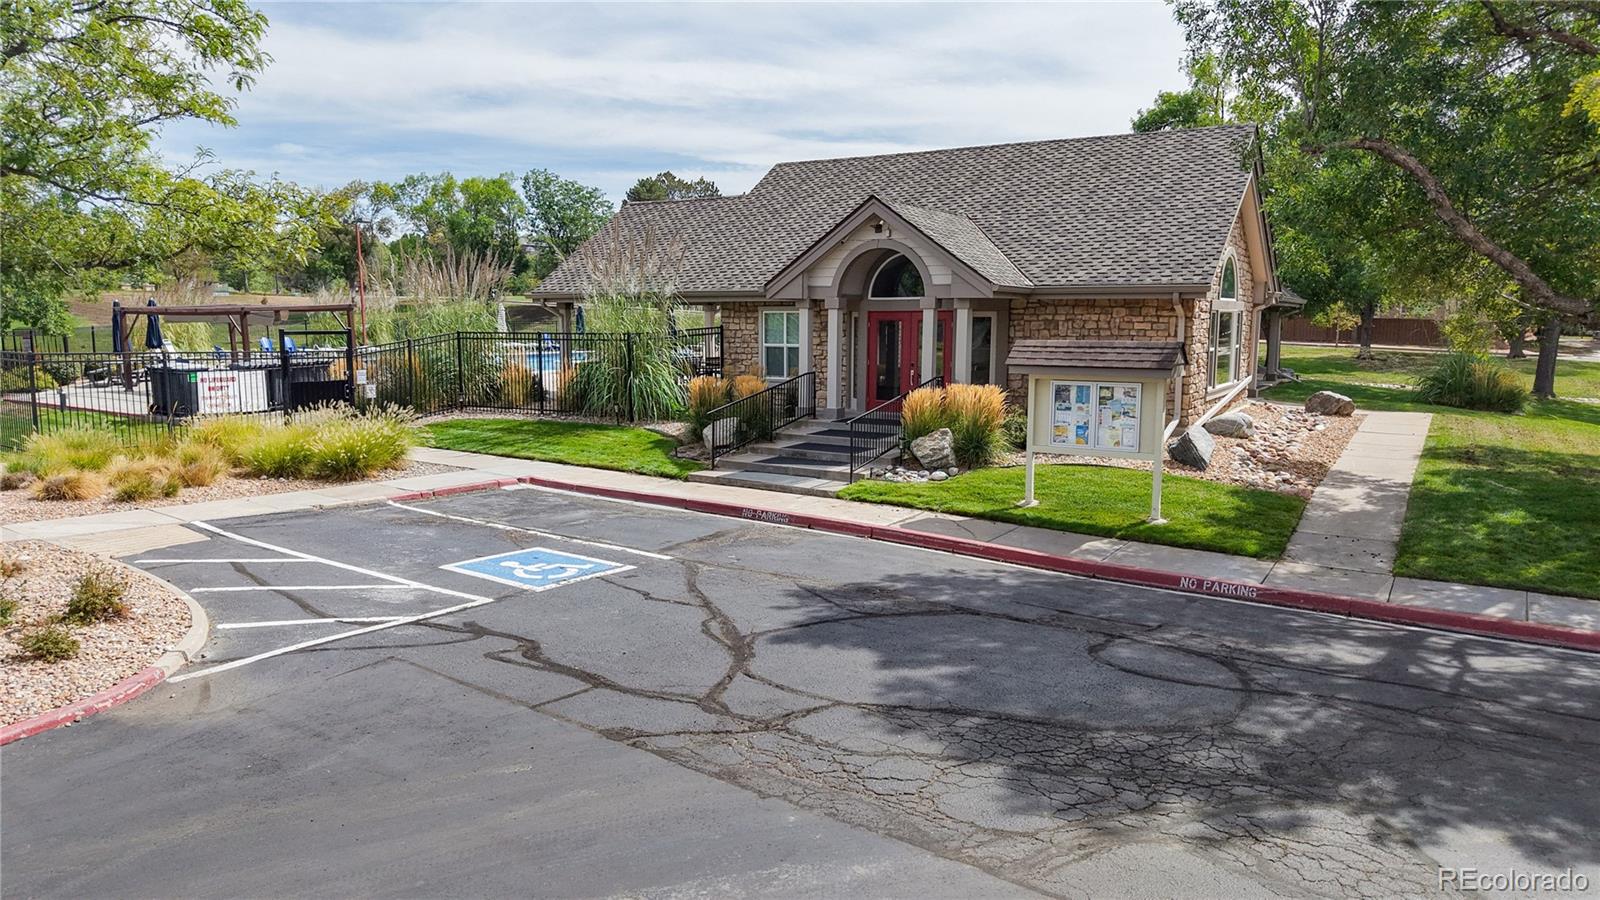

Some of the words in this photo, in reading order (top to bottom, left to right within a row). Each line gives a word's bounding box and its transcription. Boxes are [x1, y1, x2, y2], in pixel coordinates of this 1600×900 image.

[742, 508, 753, 518] NO
[756, 509, 789, 523] PARKING
[1180, 577, 1197, 589] NO
[1203, 580, 1257, 598] PARKING
